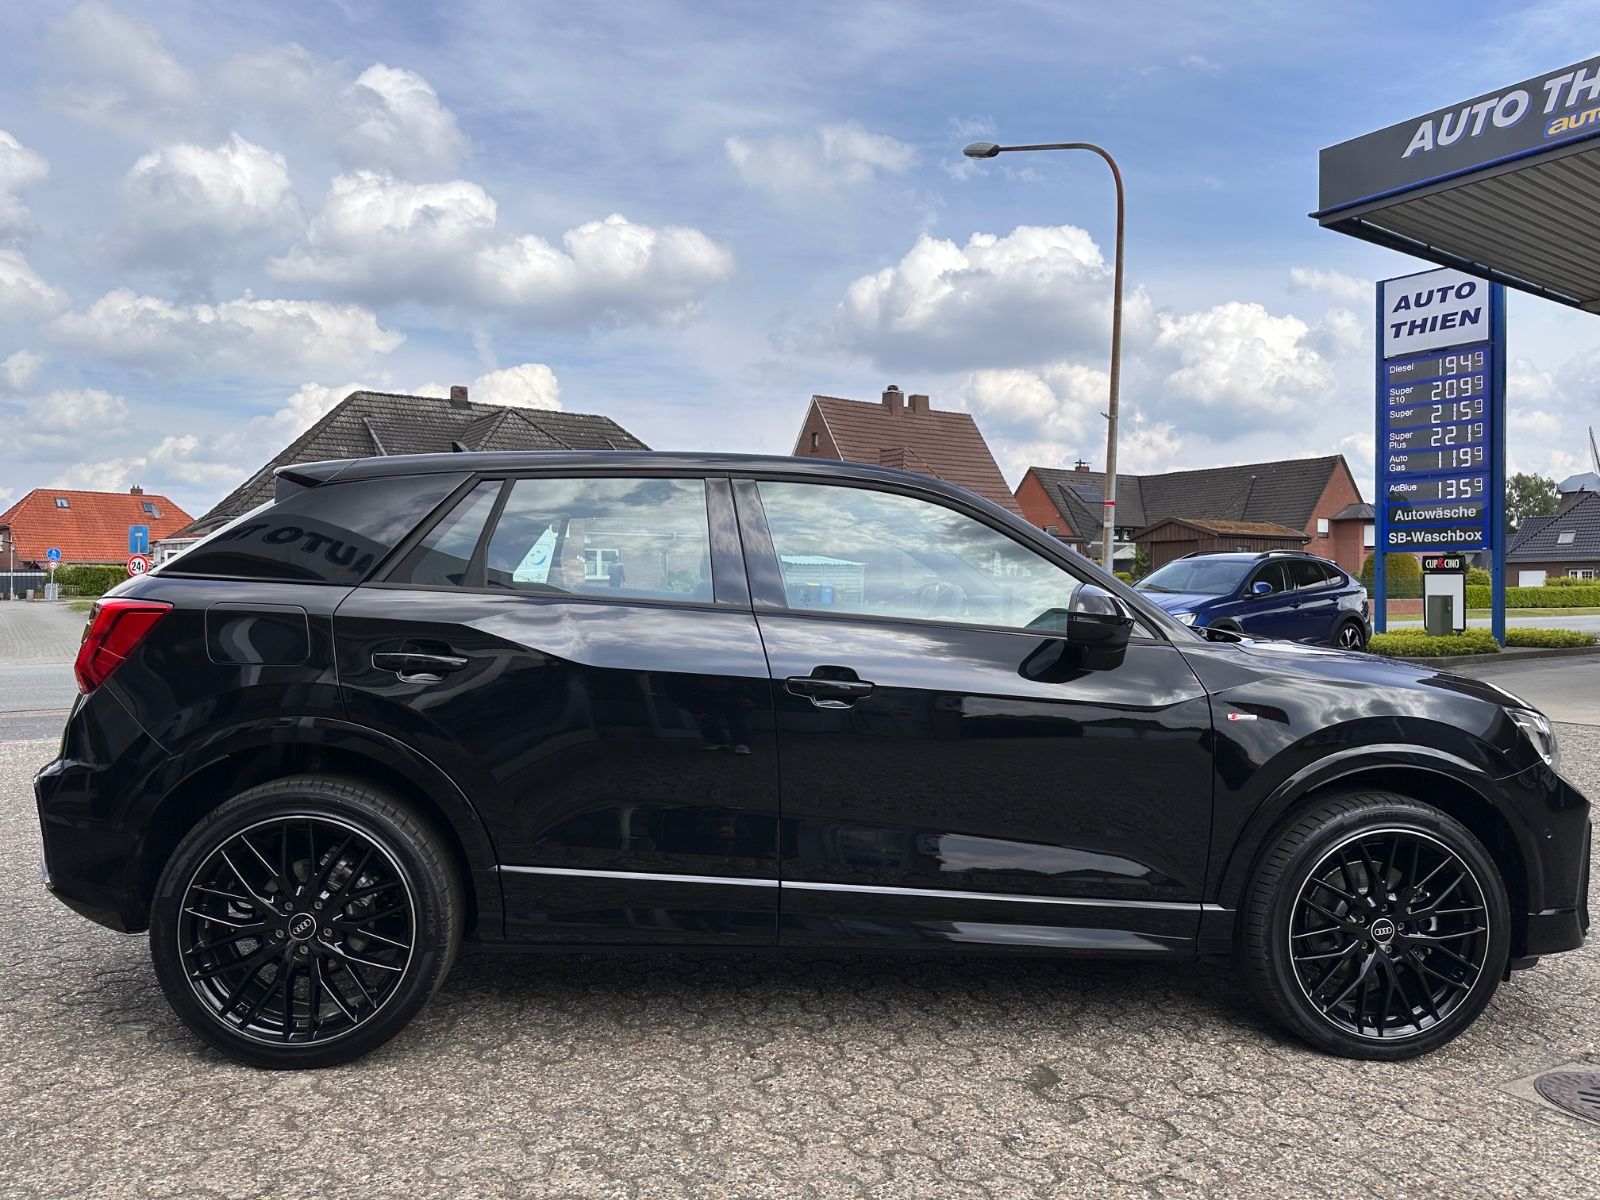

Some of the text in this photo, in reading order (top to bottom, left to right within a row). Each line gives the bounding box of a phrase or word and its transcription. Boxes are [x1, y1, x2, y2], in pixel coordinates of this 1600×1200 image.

[1401, 89, 1532, 159] AUTO
[1547, 107, 1600, 135] aut
[1392, 281, 1477, 313] AUTO
[1390, 307, 1481, 339] THIEN
[1389, 363, 1414, 374] Diesel
[1389, 387, 1414, 397] Super
[1389, 396, 1405, 405] E10
[1389, 409, 1413, 419] Super
[1389, 432, 1413, 441] Super
[1389, 441, 1407, 450] Plus
[1389, 455, 1408, 463] Auto
[1389, 464, 1406, 472] Gas
[1389, 483, 1417, 493] AdBlue
[1394, 505, 1477, 521] Autowäsche
[1388, 529, 1482, 544] SB-Waschbox
[1425, 557, 1460, 569] CUP&CINO
